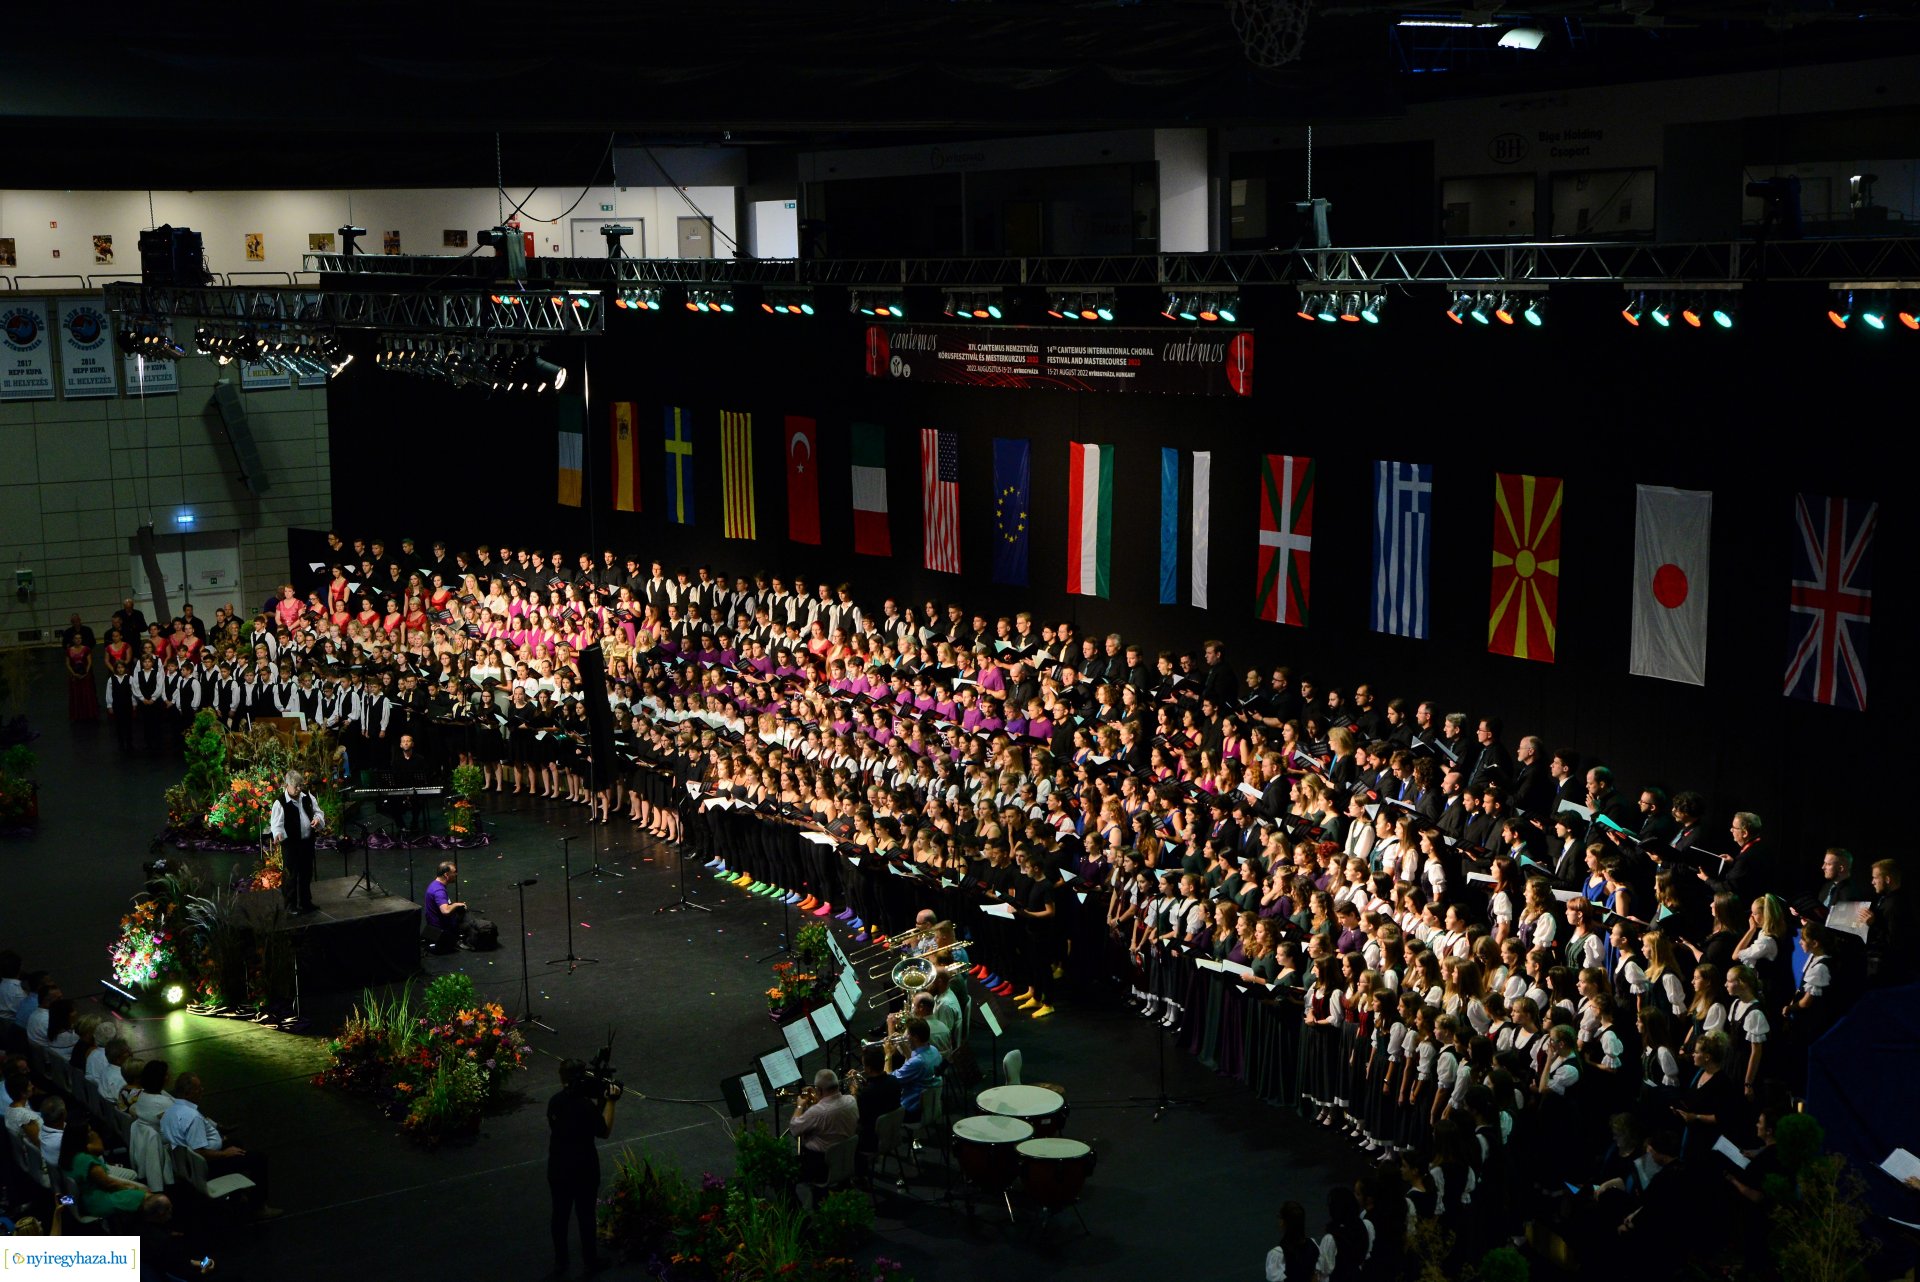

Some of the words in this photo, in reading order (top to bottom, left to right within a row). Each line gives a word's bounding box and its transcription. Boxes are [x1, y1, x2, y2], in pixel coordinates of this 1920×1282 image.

[1496, 138, 1520, 158] BH
[890, 328, 938, 354] cantemus
[977, 344, 1005, 352] CANTEMUS
[1006, 344, 1039, 353] NEMZETKÖZI
[1057, 346, 1087, 354] CANTEMUS
[1087, 346, 1130, 355] INTERNATIONAL
[1130, 347, 1154, 356] CHORAL
[1162, 336, 1225, 367] cantemus
[938, 350, 978, 361] KÓRUSFESZTIVÁL
[979, 353, 985, 361] ÉS
[985, 354, 1026, 363] MESTERKURZUS
[1047, 356, 1071, 364] FESTIVAL
[1071, 357, 1083, 365] AND
[1084, 357, 1127, 366] MASTERCOURSE
[17, 359, 32, 367] 2017
[1059, 368, 1077, 376] AUGUST
[1077, 369, 1088, 377] 2022
[13, 378, 49, 387] HELYEZÉS
[77, 376, 112, 385] HELYEZÉS
